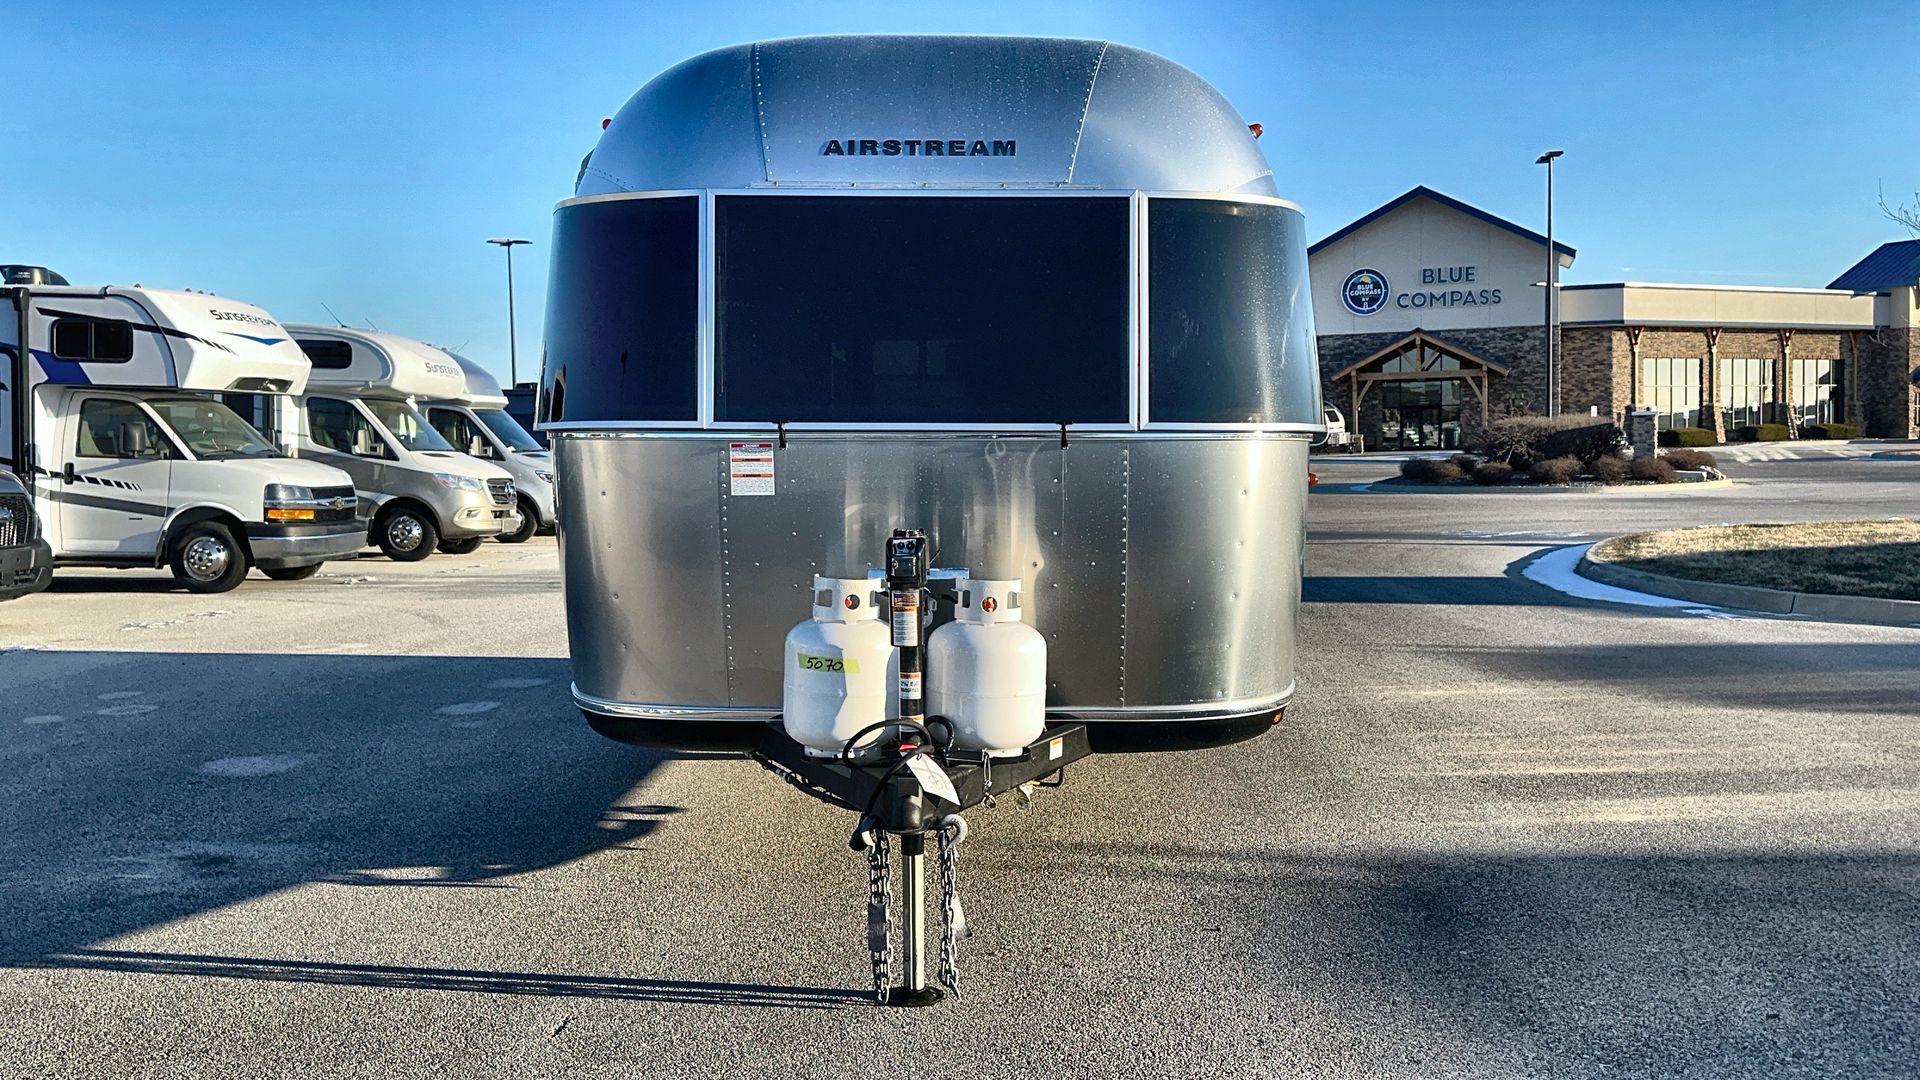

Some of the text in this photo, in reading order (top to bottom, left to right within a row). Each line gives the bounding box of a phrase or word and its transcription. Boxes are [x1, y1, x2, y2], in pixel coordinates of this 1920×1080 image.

[823, 139, 1016, 157] AIRSTREAM
[1422, 266, 1476, 284] BLUE
[1397, 289, 1502, 308] COMPASS
[806, 657, 843, 672] 5070
